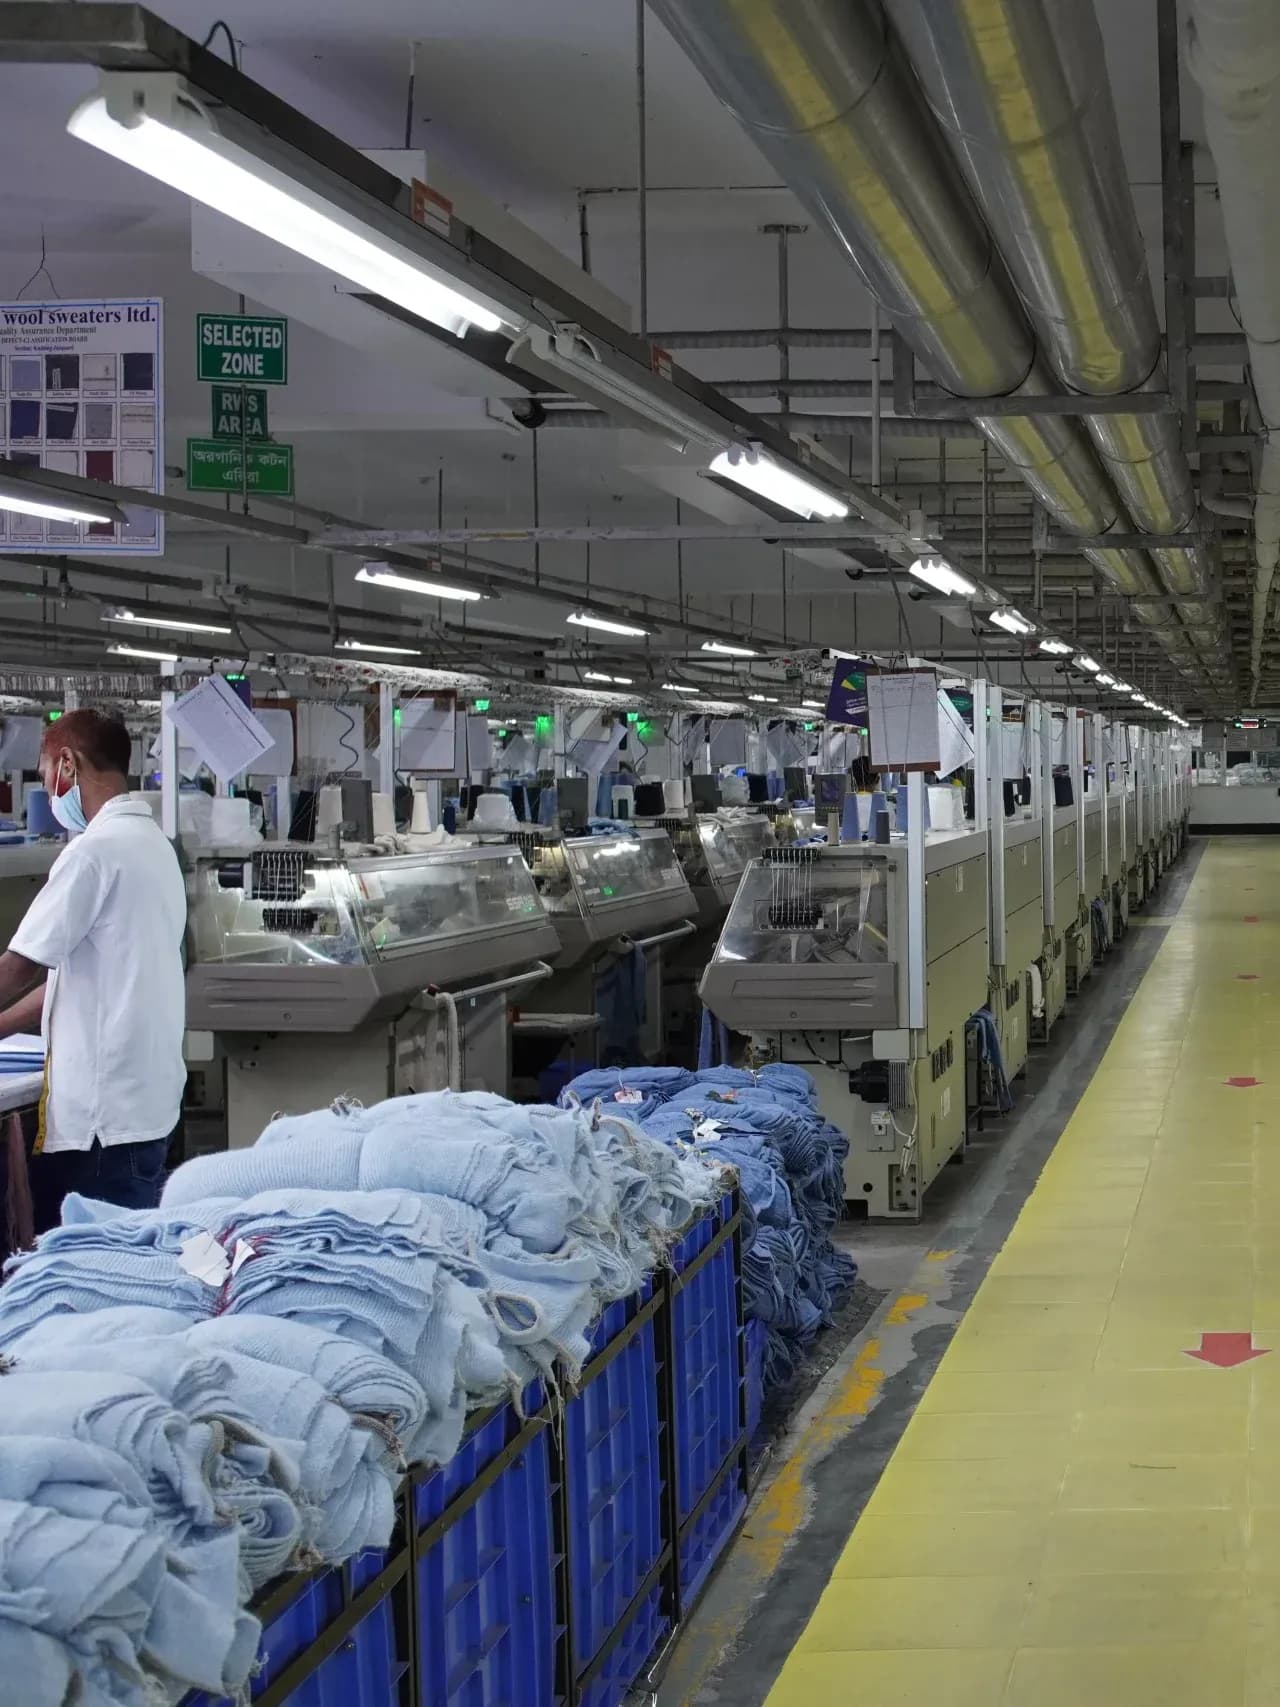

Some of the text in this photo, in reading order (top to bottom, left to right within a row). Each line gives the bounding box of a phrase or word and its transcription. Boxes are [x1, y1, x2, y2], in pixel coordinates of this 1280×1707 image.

[4, 306, 156, 325] wool sweaters ltd.
[202, 323, 283, 349] SELECTED
[221, 352, 264, 376] ZONE
[217, 415, 263, 435] AREA
